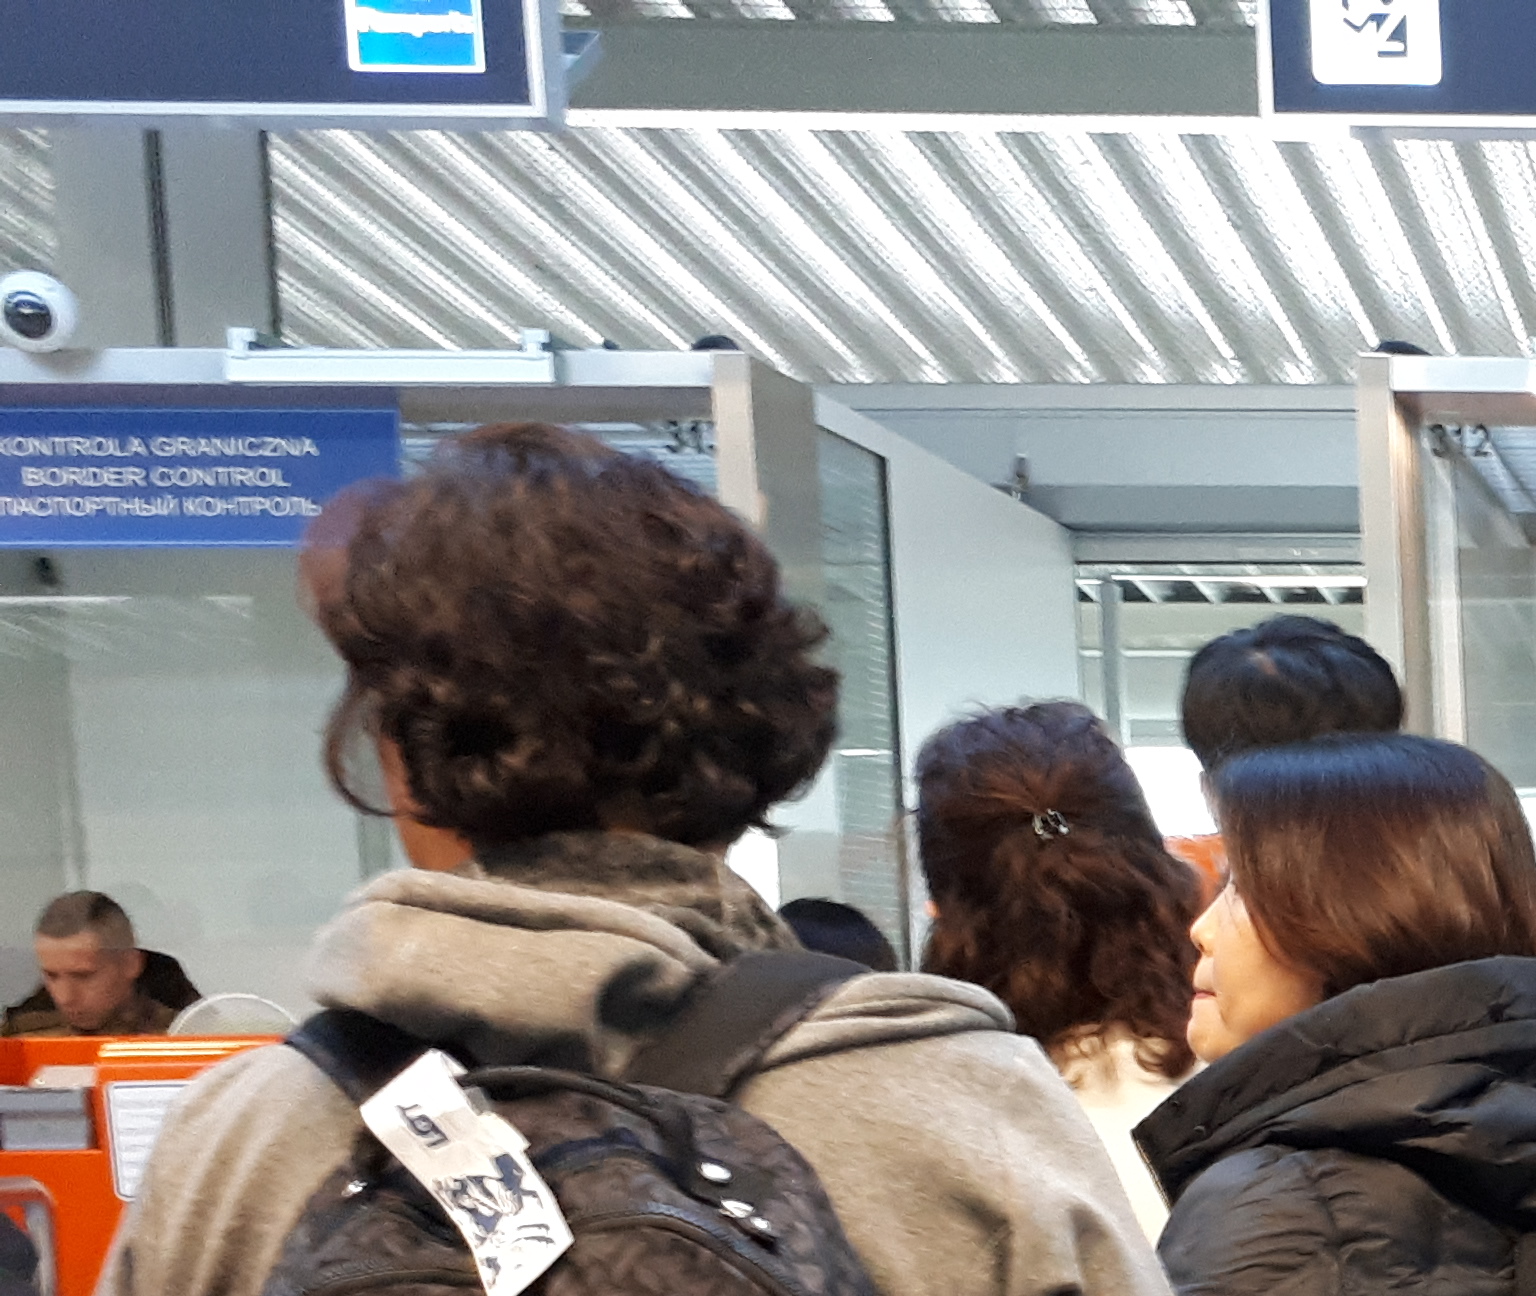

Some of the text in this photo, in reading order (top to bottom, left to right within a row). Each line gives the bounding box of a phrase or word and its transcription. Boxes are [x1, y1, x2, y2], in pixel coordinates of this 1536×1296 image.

[151, 436, 320, 456] GRANICZNA
[21, 466, 292, 487] BORDER CONTROL
